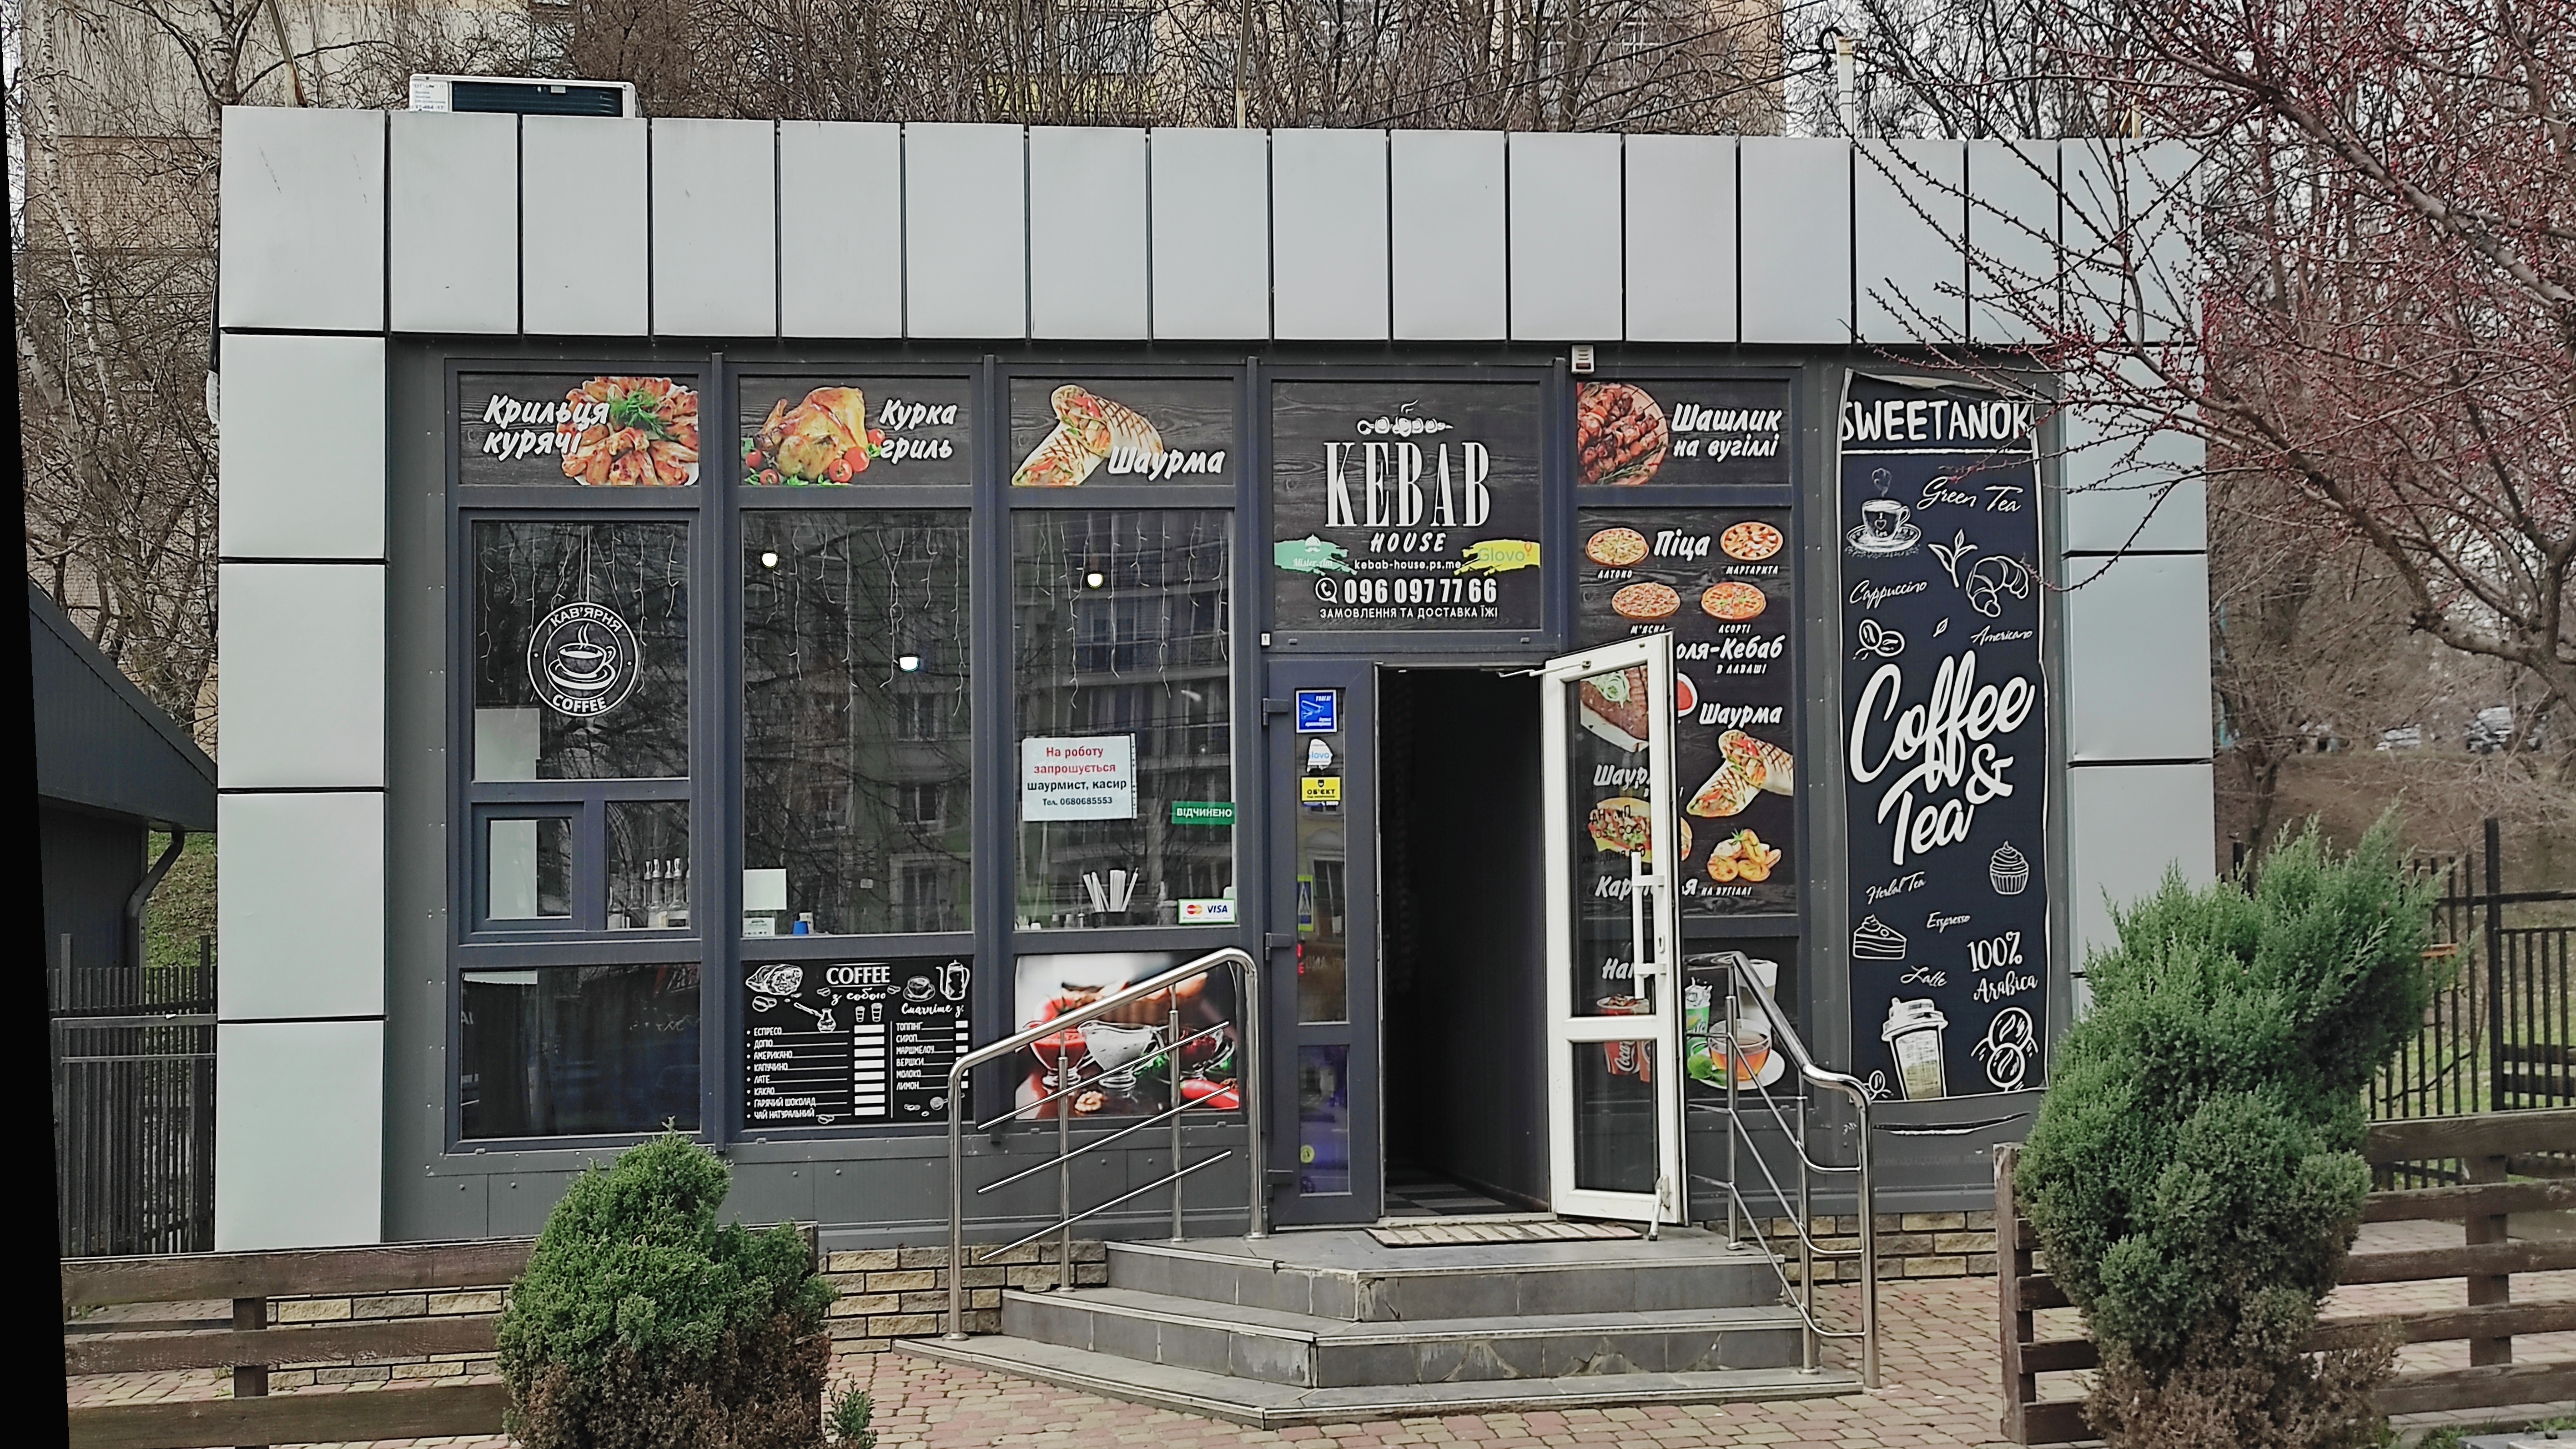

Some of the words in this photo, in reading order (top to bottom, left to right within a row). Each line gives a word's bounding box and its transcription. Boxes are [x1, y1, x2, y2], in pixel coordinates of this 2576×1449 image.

[483, 395, 610, 431] Крильця
[879, 399, 958, 431] Курка
[1671, 403, 1783, 431] Шашлик
[1842, 400, 2032, 441] SWEETANOK
[483, 429, 582, 461] курячі
[881, 437, 953, 464] гриль
[1673, 440, 1700, 457] на
[1708, 433, 1780, 462] вугіллі
[1106, 445, 1225, 481] Шаурма
[1324, 442, 1490, 528] KEBAB
[1916, 476, 1977, 511] Green
[1985, 486, 2024, 512] Tea
[1370, 532, 1447, 553] HOUSE
[1654, 529, 1711, 561] Піца
[1478, 547, 1526, 562] Glovo
[1355, 560, 1461, 571] kebab-house.ps.me
[1725, 565, 1778, 575] МАРГАРИТА
[1344, 578, 1388, 603] 096
[1395, 578, 1435, 603] 097
[1440, 578, 1463, 603] 77
[1468, 578, 1497, 603] 66
[1849, 580, 1929, 610] Cappuccino
[1320, 608, 1397, 619] ЗАМОВЛЕННЯ
[1400, 608, 1414, 618] ТА
[1417, 607, 1478, 620] ДОСТАВКА
[1481, 605, 1498, 618] ЇЖІ
[1718, 623, 1751, 634] АСОРТІ
[1970, 625, 2035, 647] Americano
[1726, 663, 1767, 674] ЛАВАШІ
[552, 695, 607, 713] COFFEE
[1699, 703, 1783, 728] Шаурма
[1849, 650, 2036, 793] Coffee
[1965, 743, 2015, 805] &
[1046, 747, 1061, 757] На
[1065, 746, 1104, 759] роботу
[1034, 764, 1116, 776] запрошується
[1027, 781, 1089, 793] шаурмист,
[1093, 780, 1127, 791] касир
[1060, 797, 1113, 805] 0680685553
[1176, 807, 1232, 818] ВІДЧИНЕНО
[1878, 758, 1975, 865] Tea
[1866, 877, 1904, 905] Herbal
[1903, 871, 1926, 892] Tea
[1208, 905, 1227, 913] VISA
[1926, 911, 1971, 933] Espresso
[1967, 931, 2022, 972] 100%
[826, 966, 890, 984] COFFEE
[1900, 965, 1947, 987] Latte
[846, 987, 886, 1000] собою
[901, 1003, 953, 1015] Смачніше
[754, 1027, 782, 1037] ЕСПРЕСО
[896, 1034, 918, 1043] СИРОП
[754, 1050, 793, 1060] АМЕРИКАНО
[896, 1045, 934, 1055] МАРШМЕЛОУ
[754, 1063, 788, 1071] КАПУЧИНО
[896, 1057, 924, 1067] ВЕРШКИ
[754, 1075, 770, 1084] ЛАТЕ
[896, 1069, 922, 1079] МОЛОКО
[754, 1087, 775, 1096] КАКАО
[896, 1081, 919, 1090] ЛИМОН
[754, 1097, 783, 1108] ГАРЯЧИЙ
[784, 1097, 816, 1107] ШОКОЛАД
[754, 1109, 768, 1119] ЧАЙ
[769, 1108, 815, 1119] НАТУРАЛЬНИЙ
